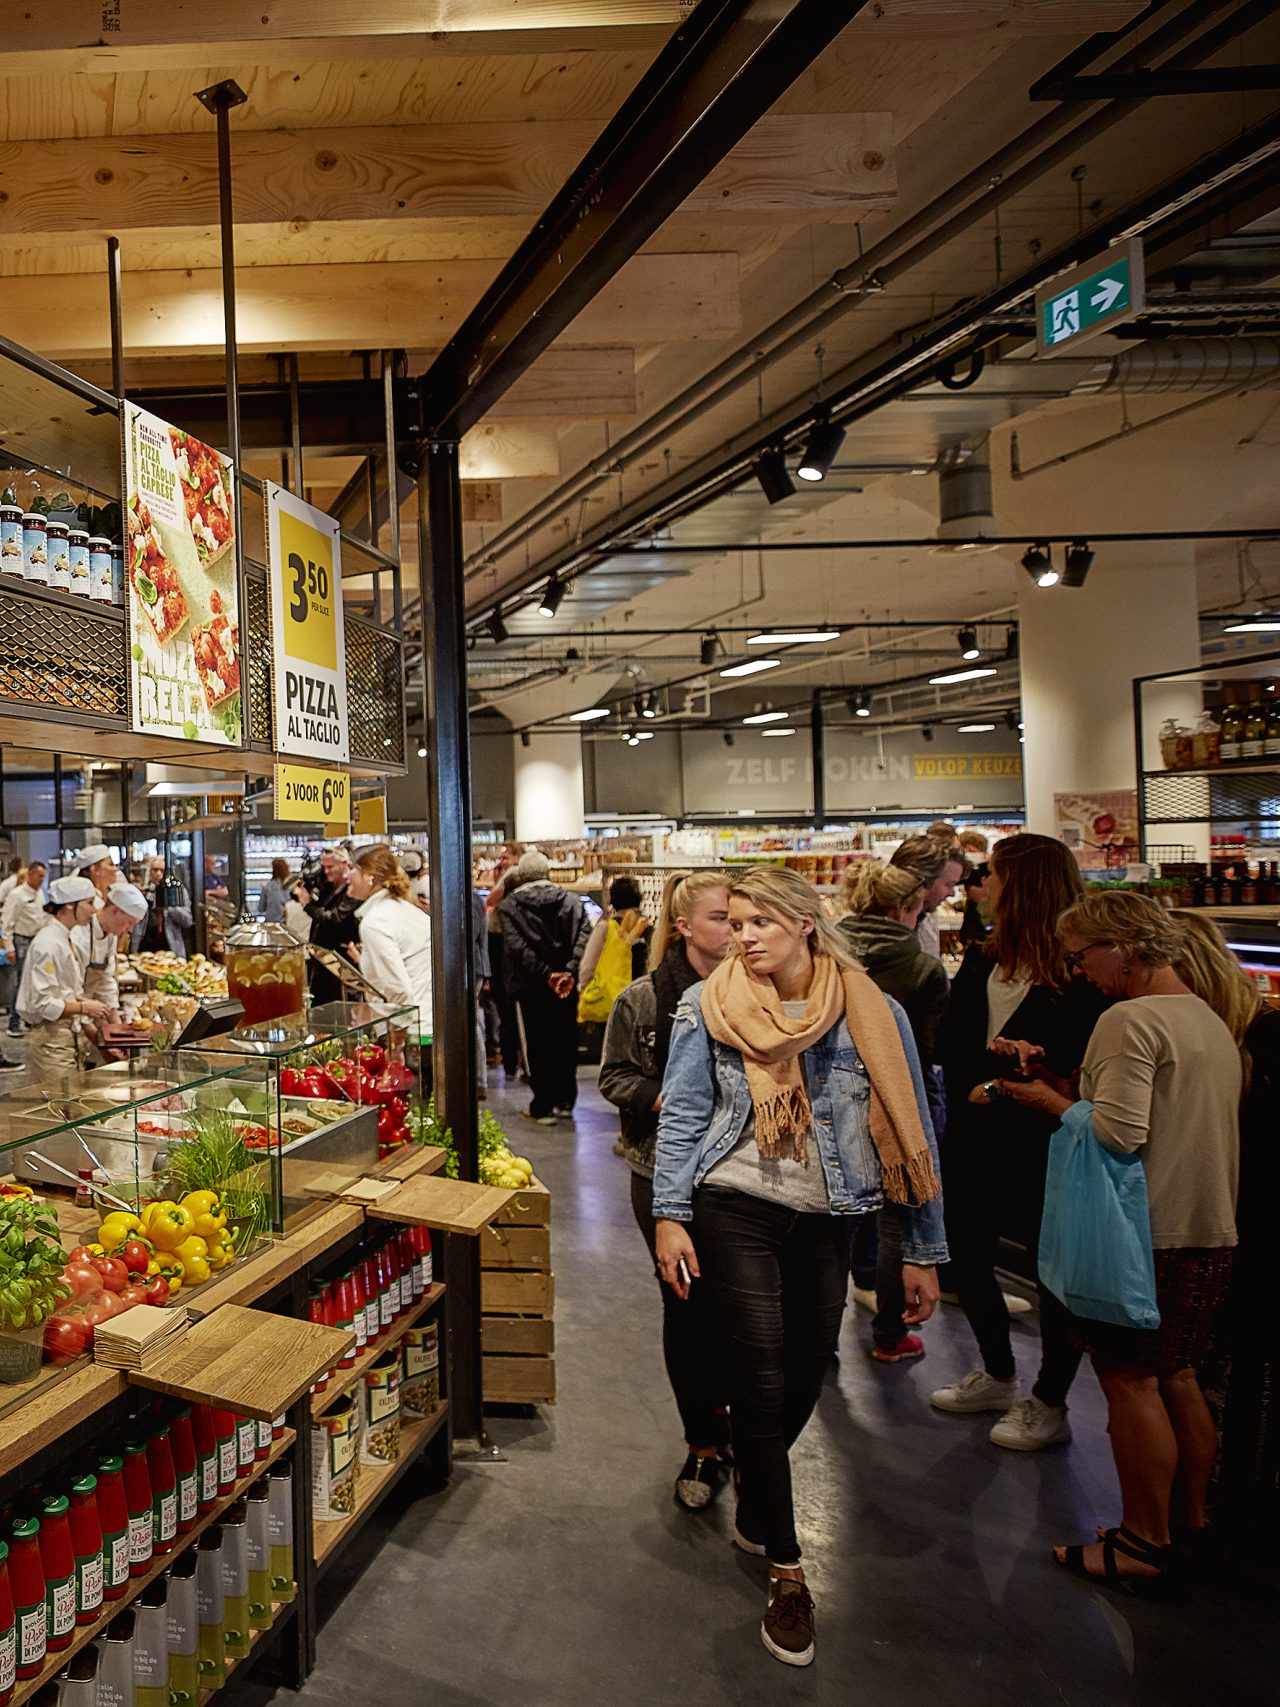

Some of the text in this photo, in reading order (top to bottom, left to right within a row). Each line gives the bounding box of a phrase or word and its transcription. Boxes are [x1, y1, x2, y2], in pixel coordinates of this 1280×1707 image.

[140, 441, 160, 465] PIZZA
[140, 458, 176, 487] AL TAGLIO
[141, 473, 174, 501] CAPRESE
[285, 671, 340, 721] PIZZA
[288, 714, 341, 746] AL TAGLIO
[727, 758, 795, 785] ZELF
[914, 758, 967, 776] VOLOP
[286, 782, 291, 801] 2
[292, 783, 319, 803] VOOR
